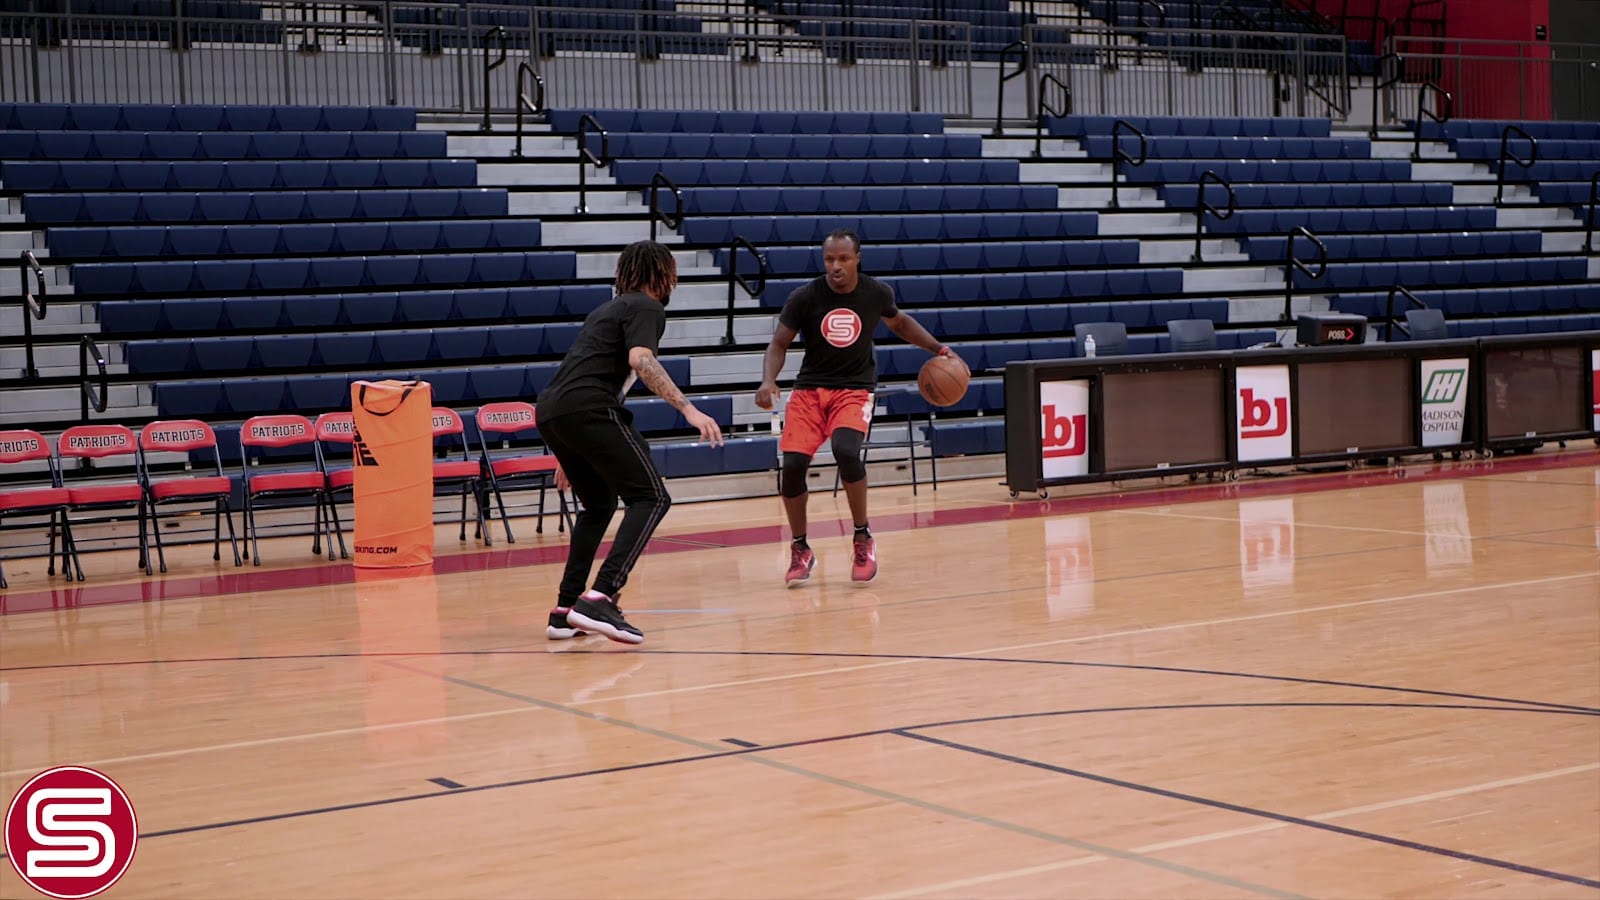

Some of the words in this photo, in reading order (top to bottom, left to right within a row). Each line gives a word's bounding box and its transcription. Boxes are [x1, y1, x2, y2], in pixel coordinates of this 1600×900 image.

[432, 416, 453, 428] OTS
[486, 410, 532, 424] PATRIOTS
[252, 423, 305, 437] PATRIOTS
[325, 422, 354, 433] PATRI
[1423, 421, 1460, 432] OSPITAL
[69, 434, 126, 448] PATRIOTS
[151, 427, 205, 442] PATRIOTS
